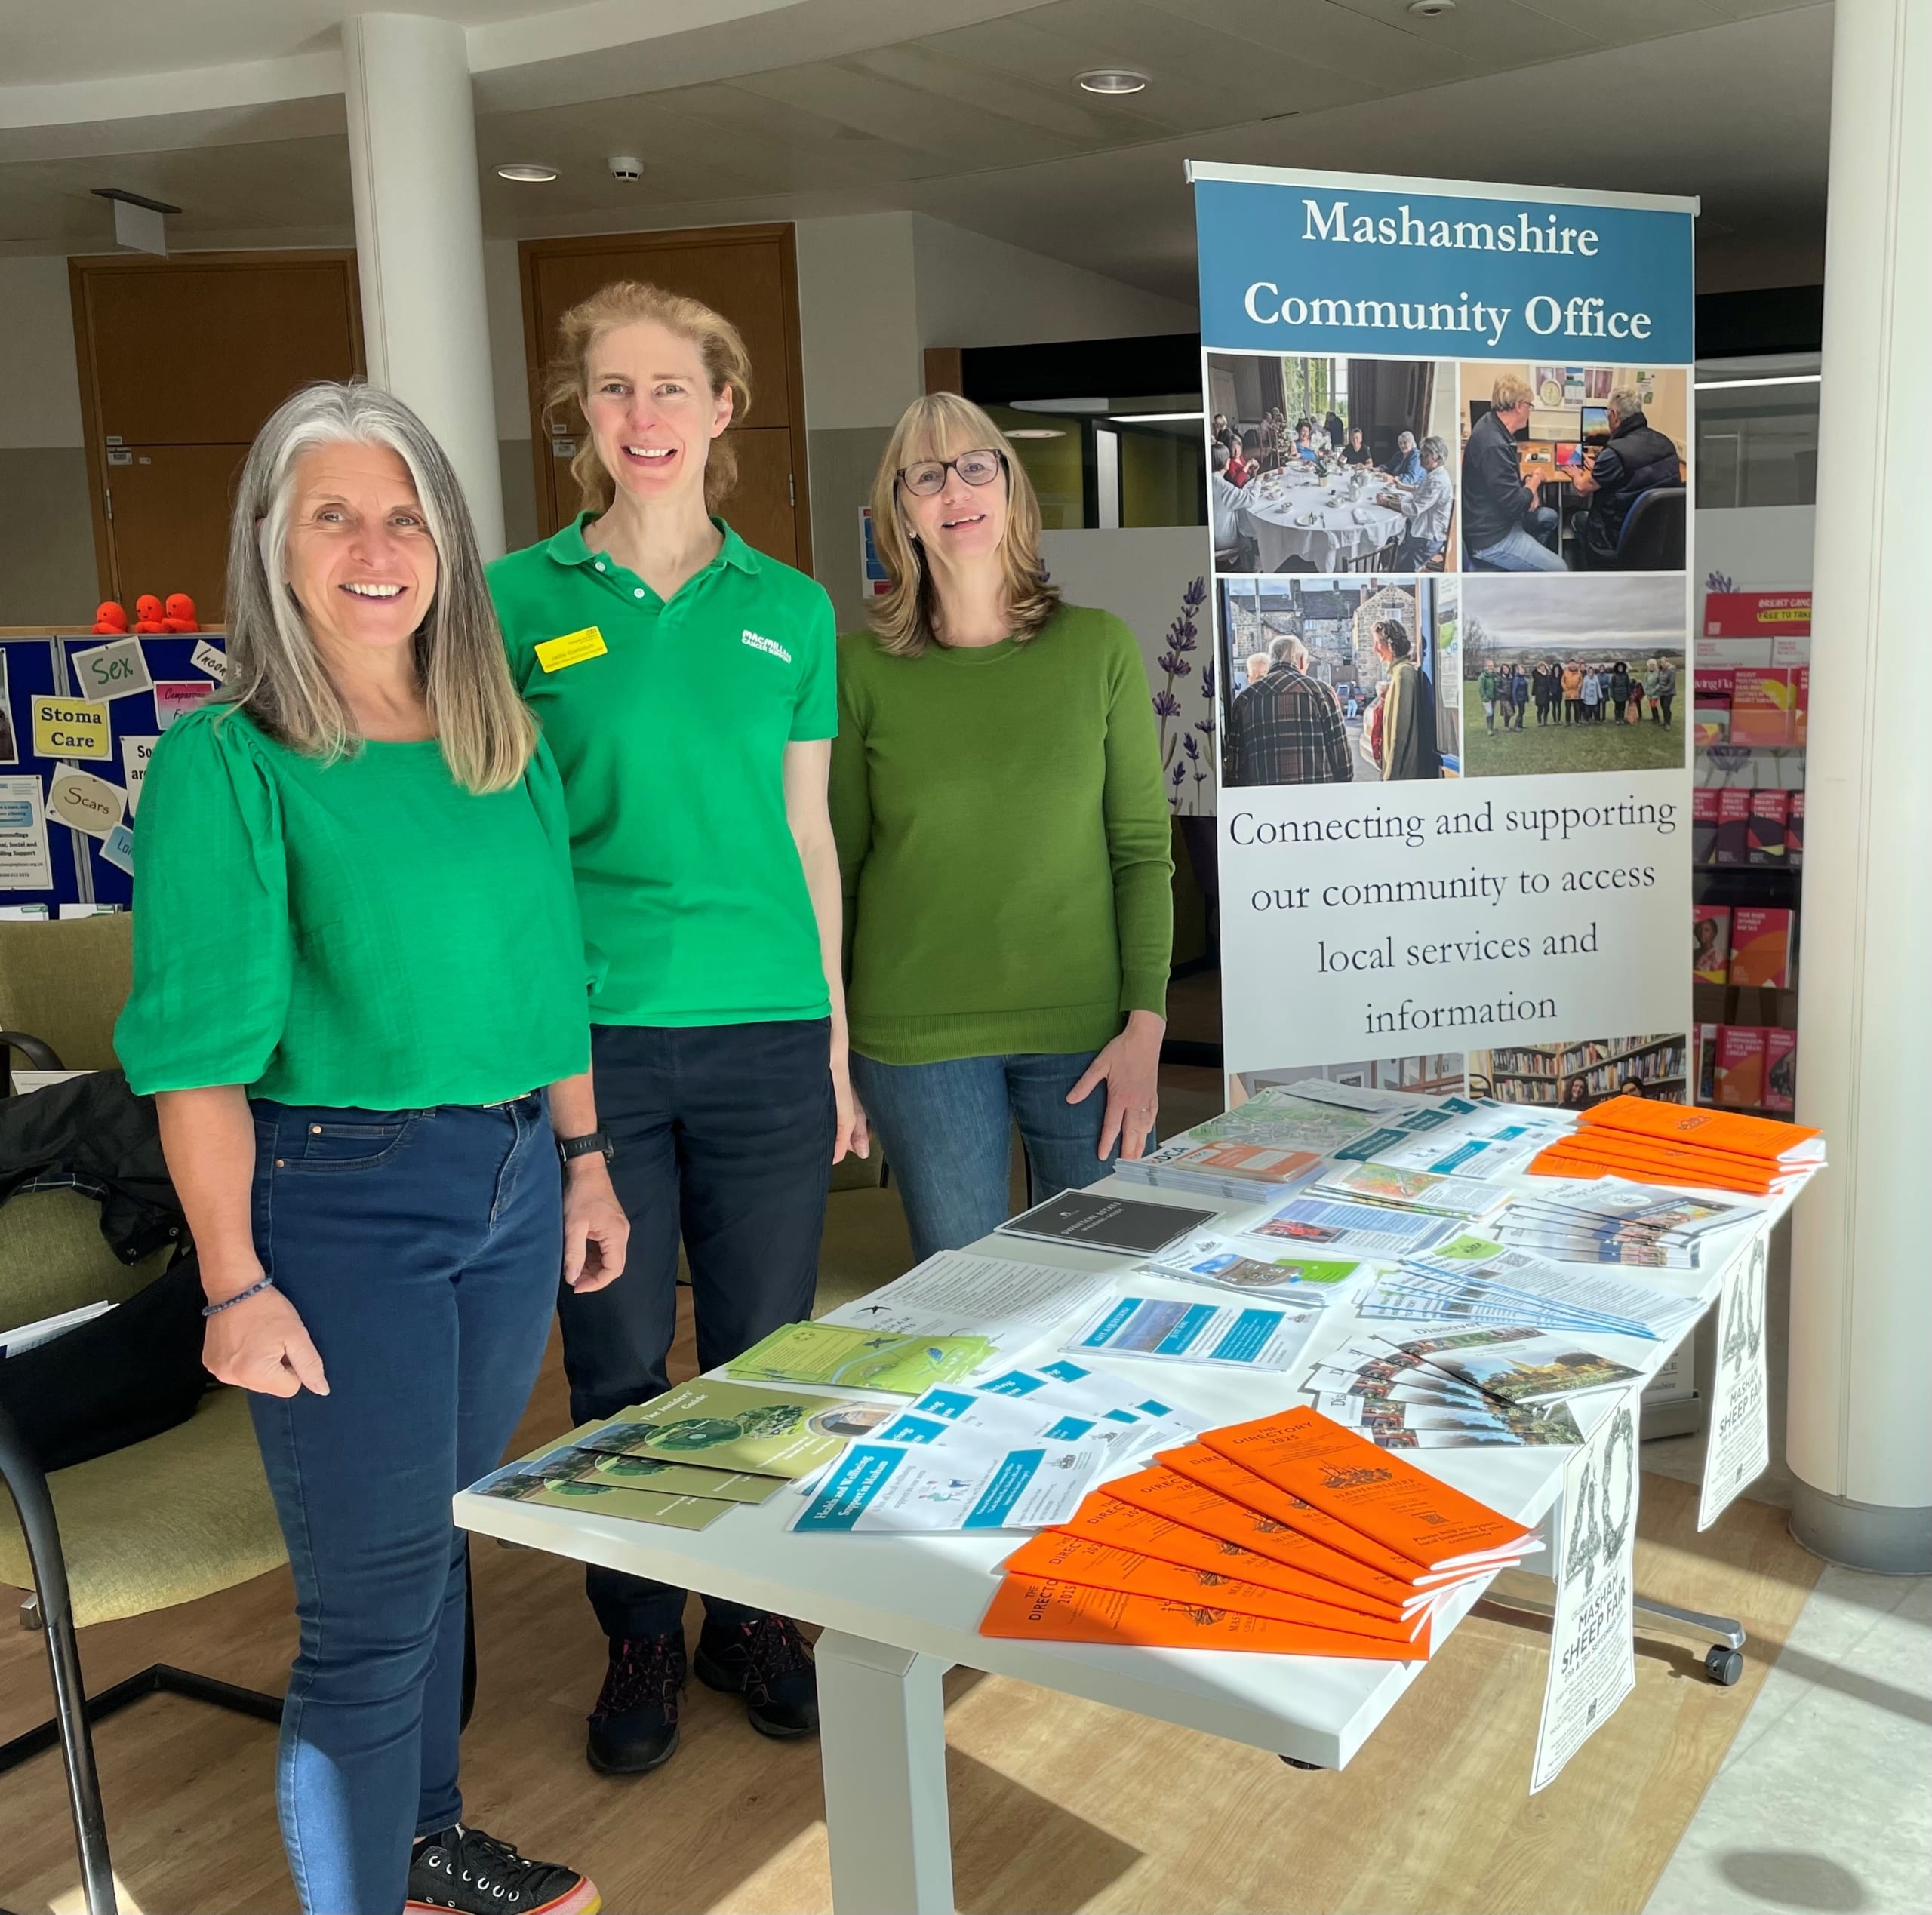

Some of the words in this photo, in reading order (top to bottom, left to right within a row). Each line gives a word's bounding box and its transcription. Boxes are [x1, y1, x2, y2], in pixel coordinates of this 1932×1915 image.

[1302, 198, 1599, 257] Mashamshire
[1244, 281, 1512, 346] Community
[1525, 295, 1652, 339] Office
[741, 638, 768, 653] CANCER
[91, 655, 134, 686] Sex
[41, 707, 103, 725] Stoma
[51, 732, 95, 748] Care
[64, 787, 109, 815] Scars
[1229, 807, 1425, 848] Connecting
[1436, 802, 1494, 836] and
[1506, 795, 1678, 841] supporting
[1251, 883, 1310, 912] our
[1322, 867, 1509, 908] community
[1519, 868, 1551, 895] to
[1561, 865, 1656, 893] access
[1318, 937, 1395, 973] local
[1407, 930, 1531, 965] services
[1543, 923, 1598, 955] and
[1364, 991, 1558, 1035] information
[1094, 1332, 1106, 1342] GOT
[1171, 1326, 1182, 1339] JUST
[1413, 1320, 1480, 1335] Discover
[1730, 1366, 1758, 1407] MASHAM
[681, 1394, 708, 1409] Guide
[1719, 1394, 1749, 1437] SHEEP
[1750, 1372, 1763, 1406] FAIR
[640, 1410, 661, 1421] The
[1232, 1421, 1313, 1445] DIRECTORY
[1269, 1434, 1300, 1444] 2025
[840, 1455, 875, 1487] Wellbeing
[865, 1460, 889, 1486] Masham
[891, 1465, 918, 1485] wellbeing
[835, 1486, 849, 1499] and
[860, 1485, 871, 1495] in
[1333, 1478, 1414, 1498] MASHAMSHIRE
[814, 1496, 838, 1519] Health
[838, 1493, 863, 1516] Support
[891, 1492, 912, 1508] support
[1055, 1536, 1073, 1546] THE
[1025, 1585, 1039, 1599] THE
[1028, 1578, 1058, 1621] DIRECTO
[1057, 1585, 1077, 1604] 2025
[1578, 1569, 1618, 1632] MASHAM
[1561, 1612, 1604, 1674] SHEEP
[1607, 1576, 1626, 1624] FAIR
